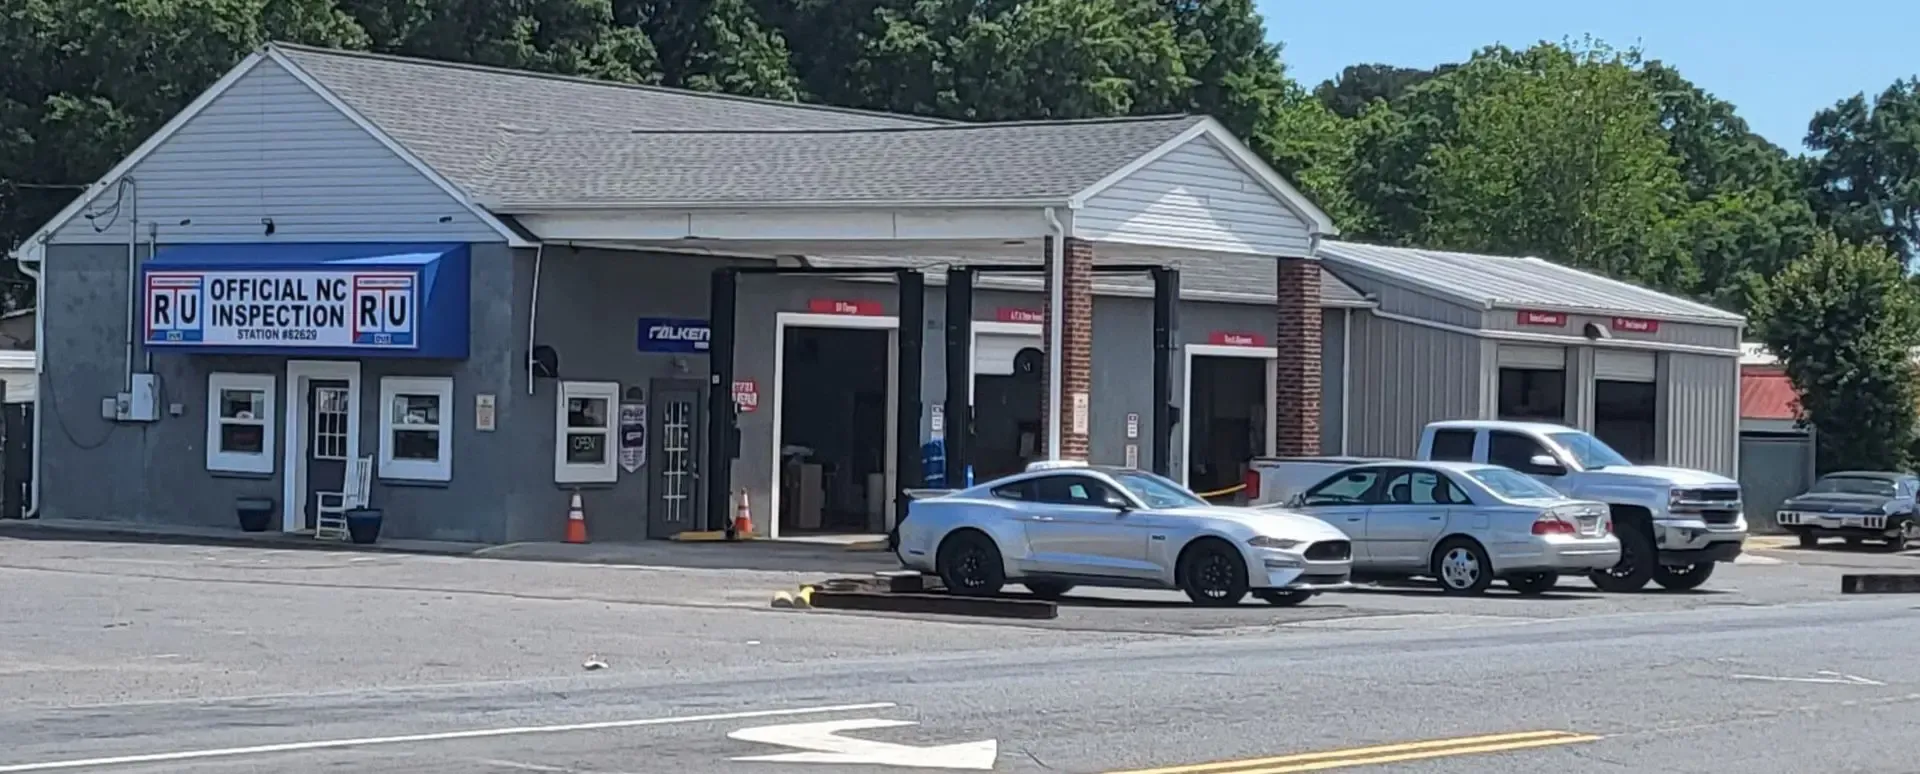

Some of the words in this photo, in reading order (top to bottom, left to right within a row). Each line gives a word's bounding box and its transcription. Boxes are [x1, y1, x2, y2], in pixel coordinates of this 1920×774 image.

[210, 278, 308, 301] OFFICIAL
[316, 278, 347, 302] NC
[154, 294, 170, 325] R
[181, 294, 196, 325] U
[212, 304, 344, 328] INSPECTION
[360, 295, 378, 327] R
[389, 295, 406, 327] U
[237, 329, 279, 340] STATION
[648, 326, 711, 341] FALKEN
